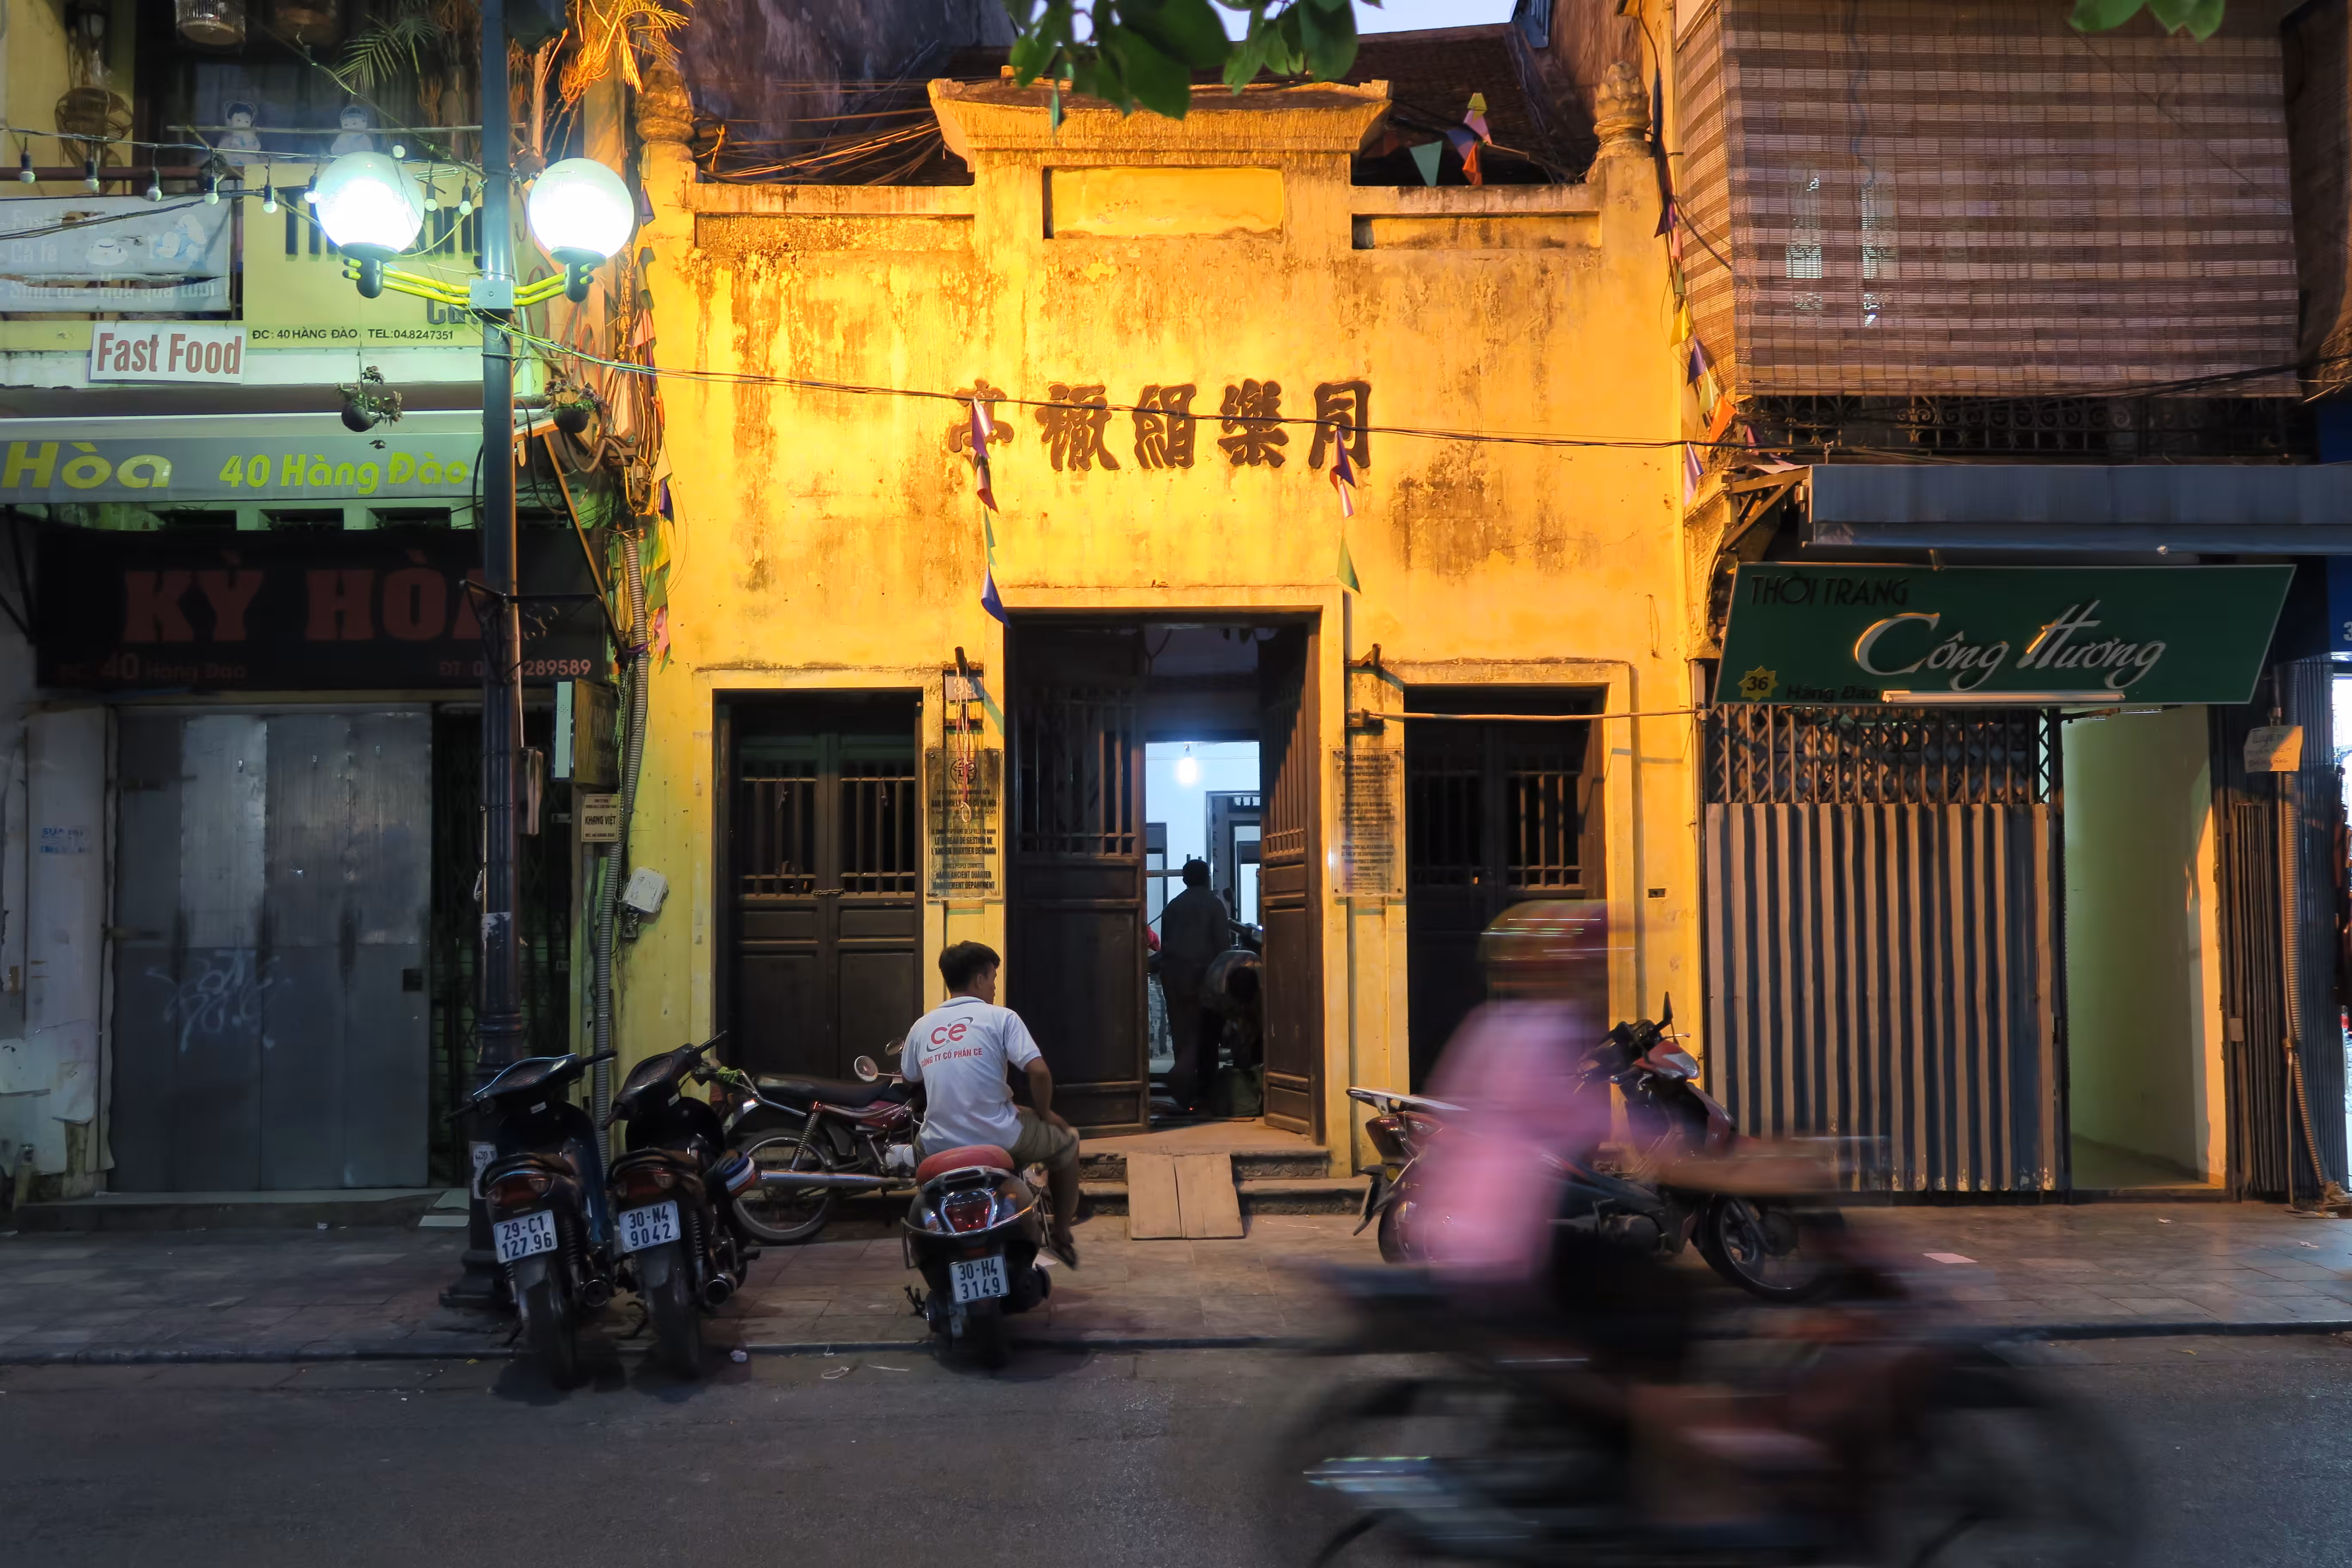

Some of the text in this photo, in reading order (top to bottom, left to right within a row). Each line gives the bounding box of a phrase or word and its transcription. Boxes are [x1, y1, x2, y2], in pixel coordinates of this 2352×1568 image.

[277, 330, 290, 338] 40
[293, 328, 327, 339] HÀNG
[331, 327, 358, 338] ĐÀO
[97, 332, 242, 374] Fast Food
[2, 441, 172, 489] Hòa
[219, 452, 469, 495] 40 Hàng Đào
[123, 549, 265, 642] KỲ
[1823, 576, 1911, 606] TRANG
[1853, 612, 2009, 691] Công
[1746, 676, 1769, 691] 36
[585, 816, 603, 825] KHANG
[951, 871, 970, 879] ANCIENT
[971, 871, 992, 879] QUARTER
[931, 1023, 967, 1045] ce
[934, 1054, 941, 1062] TY
[974, 1048, 983, 1056] CE
[503, 1215, 545, 1240] 29-C1
[630, 1223, 671, 1247] 9042
[502, 1232, 553, 1259] 127.96
[958, 1259, 998, 1281] 30-H4
[961, 1277, 1001, 1300] 3149
